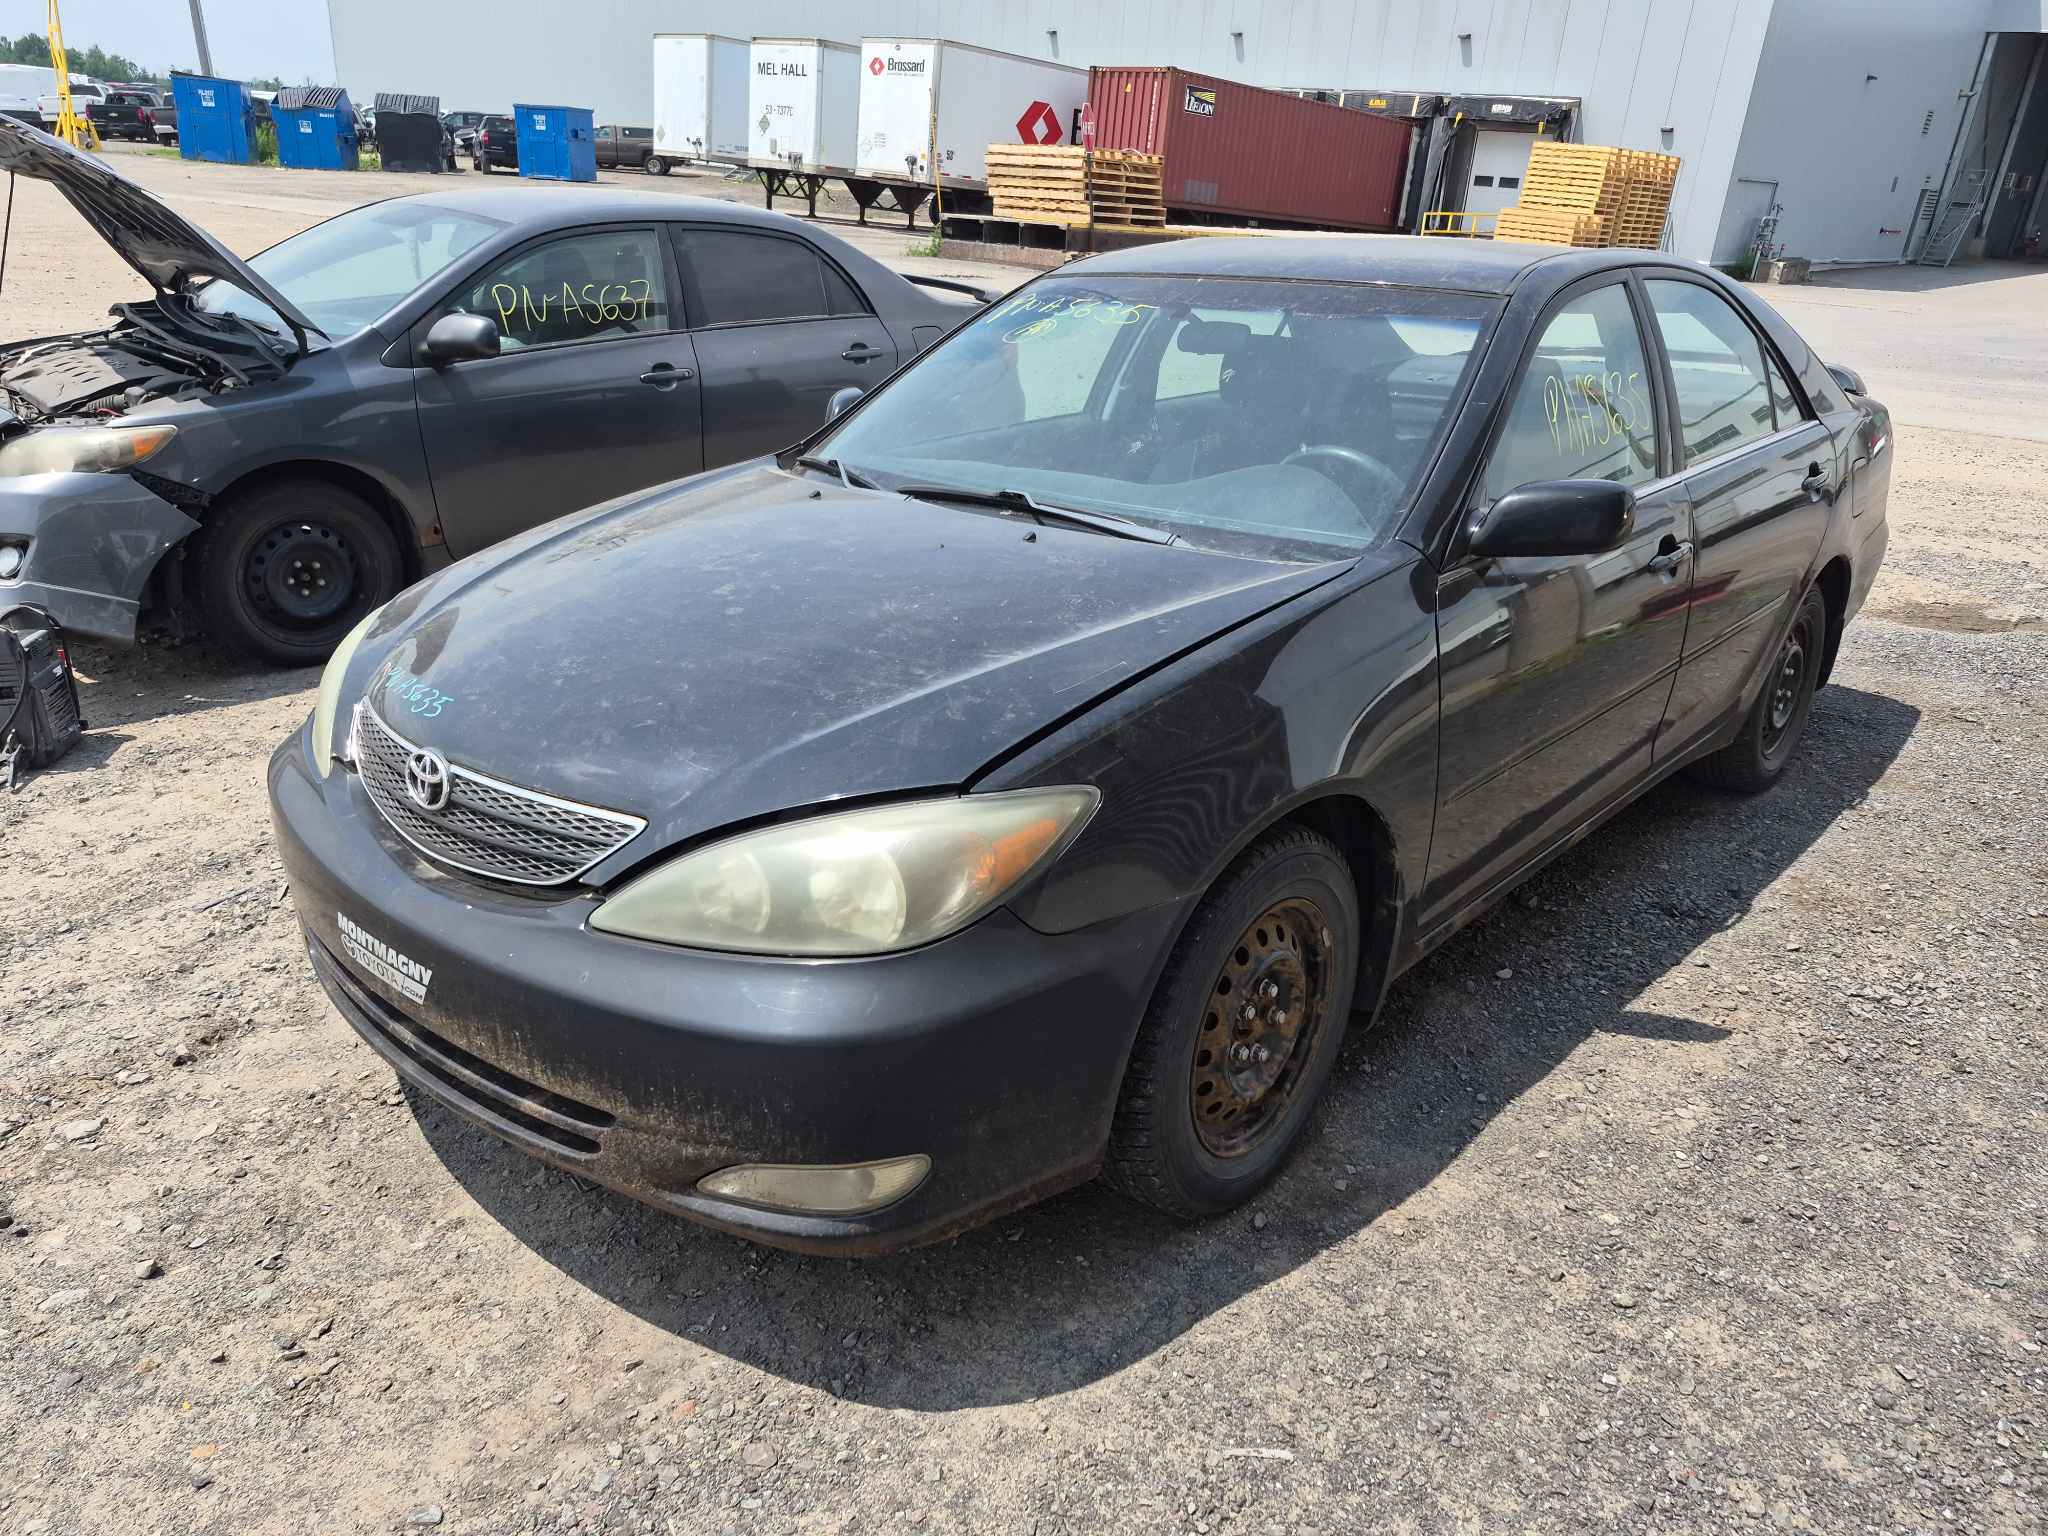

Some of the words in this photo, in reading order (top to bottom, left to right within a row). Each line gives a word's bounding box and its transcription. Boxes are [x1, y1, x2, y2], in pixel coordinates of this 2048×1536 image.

[757, 61, 778, 76] MEL
[780, 63, 808, 77] HALL
[887, 57, 926, 73] Brossard
[337, 911, 433, 986] MONTMAGNY
